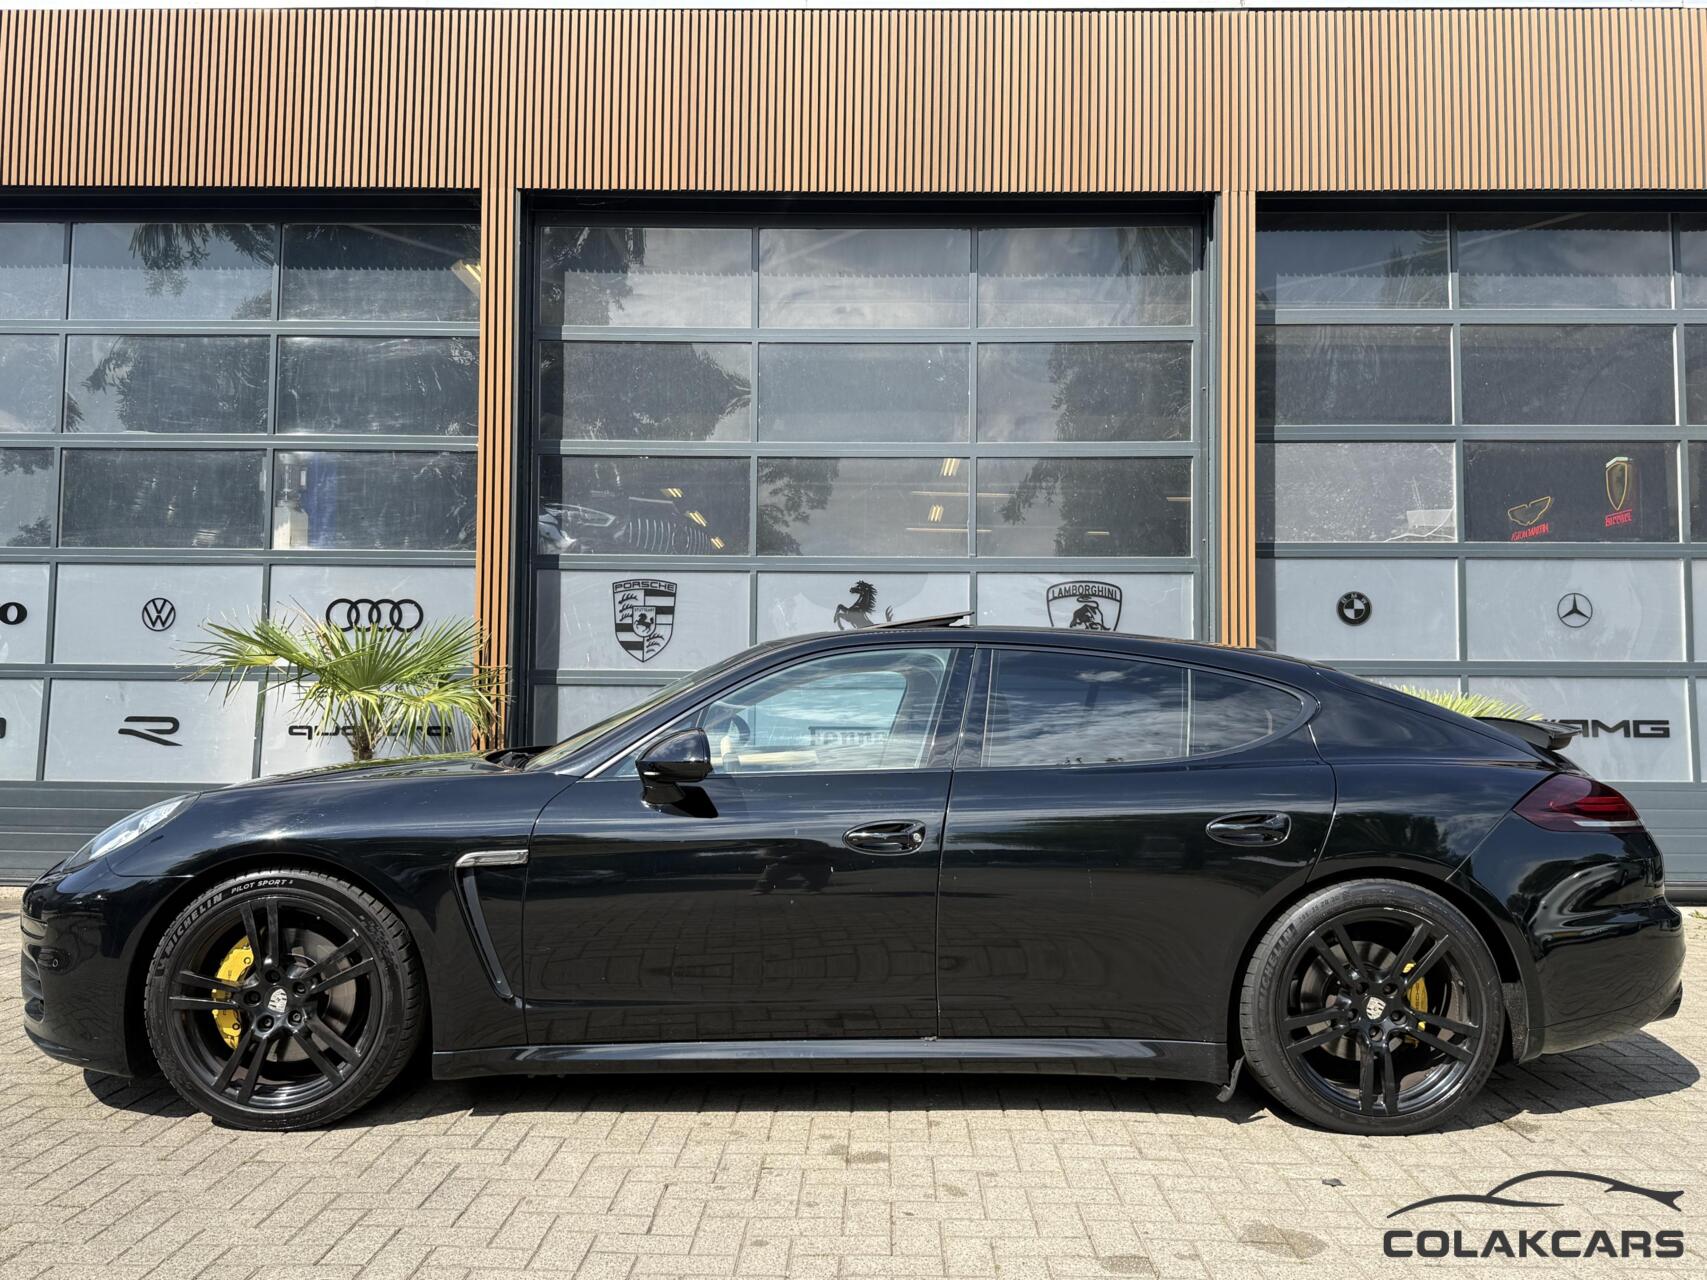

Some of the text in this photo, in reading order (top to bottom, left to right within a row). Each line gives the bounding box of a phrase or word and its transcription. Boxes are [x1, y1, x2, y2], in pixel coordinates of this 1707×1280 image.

[614, 581, 675, 592] PORSCHE
[1052, 584, 1117, 600] LAMBORGHINI
[164, 893, 223, 956] MICHELIN
[231, 882, 255, 894] PILOT
[257, 879, 287, 887] SPORT
